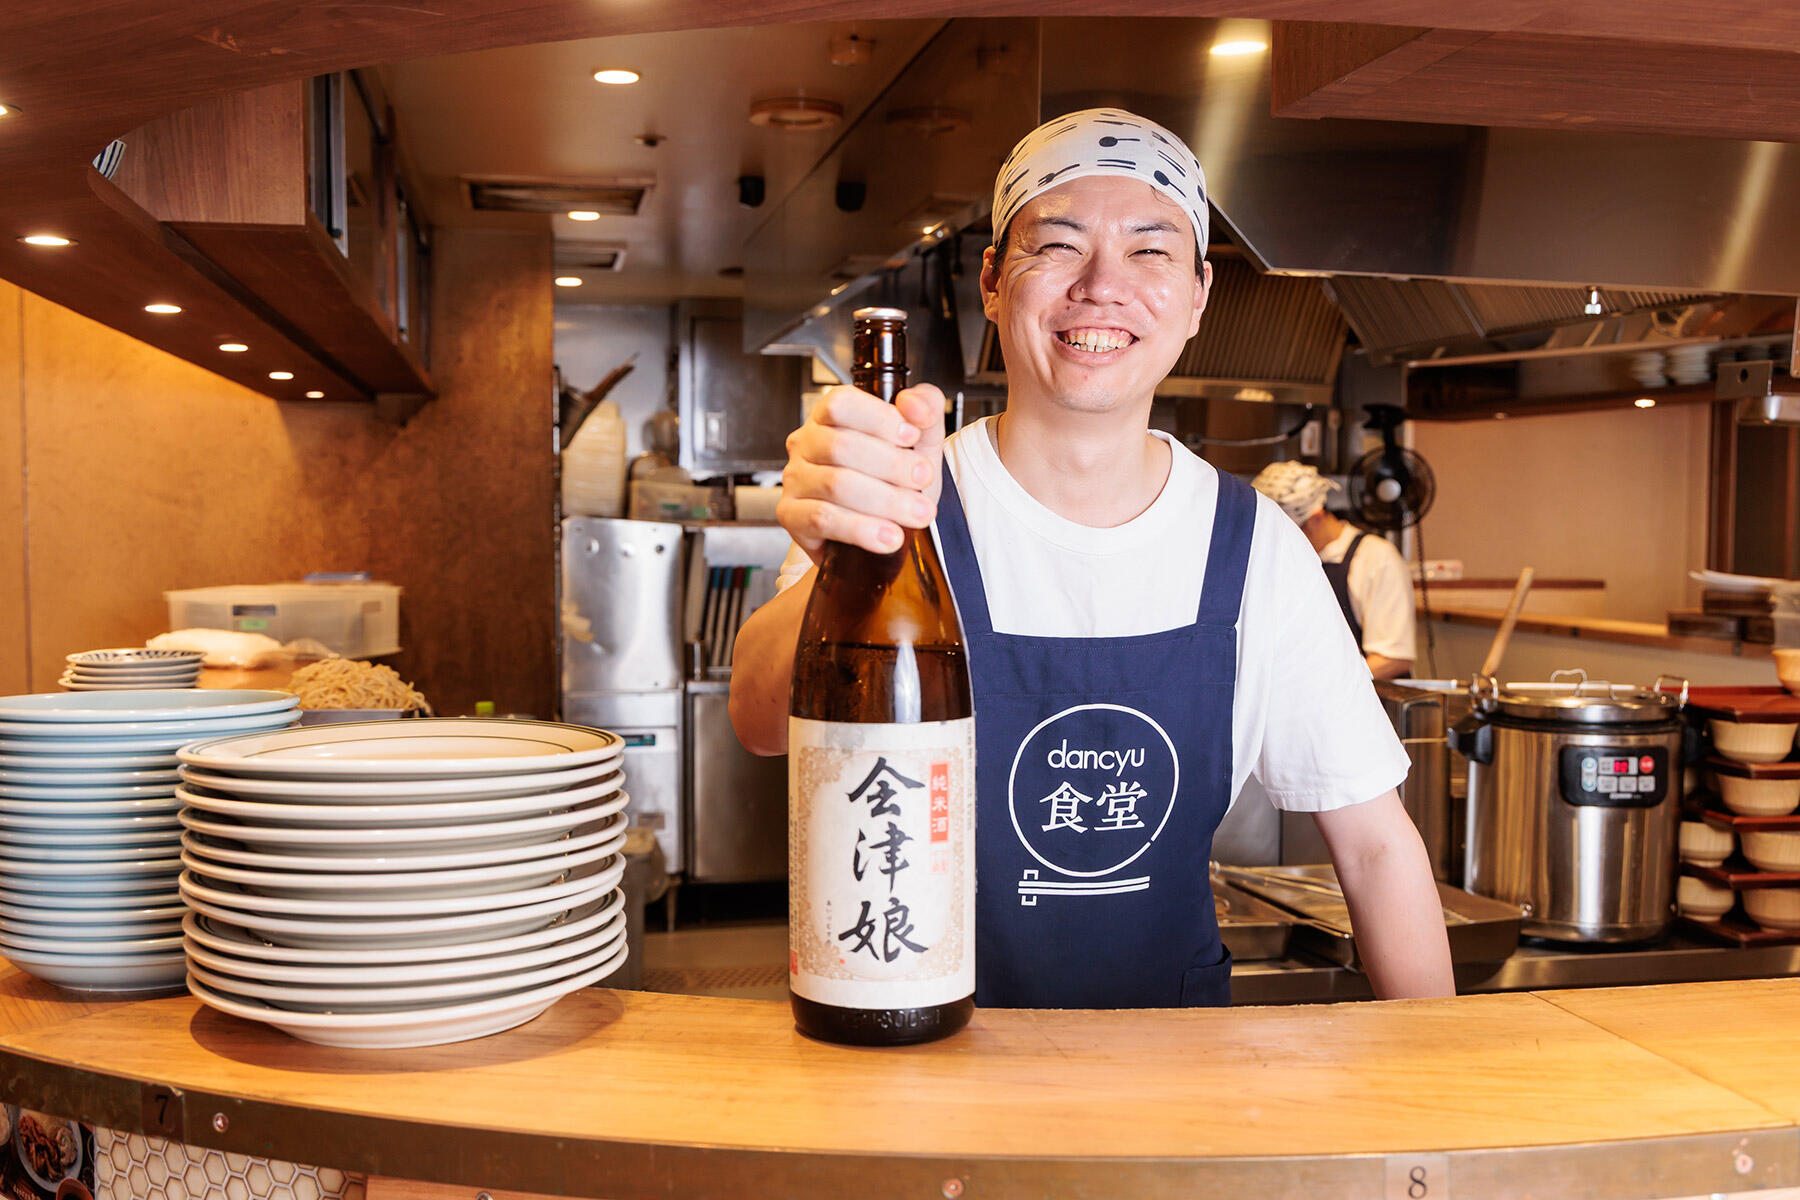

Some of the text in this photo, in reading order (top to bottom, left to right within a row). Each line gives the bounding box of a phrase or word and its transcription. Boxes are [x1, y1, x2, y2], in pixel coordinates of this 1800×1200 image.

[1047, 738, 1145, 777] dancyu
[932, 774, 949, 833] 純米酒
[1039, 780, 1148, 834] 食堂
[838, 756, 929, 963] 会津娘
[155, 1094, 168, 1124] 7
[1408, 1165, 1427, 1199] 8
